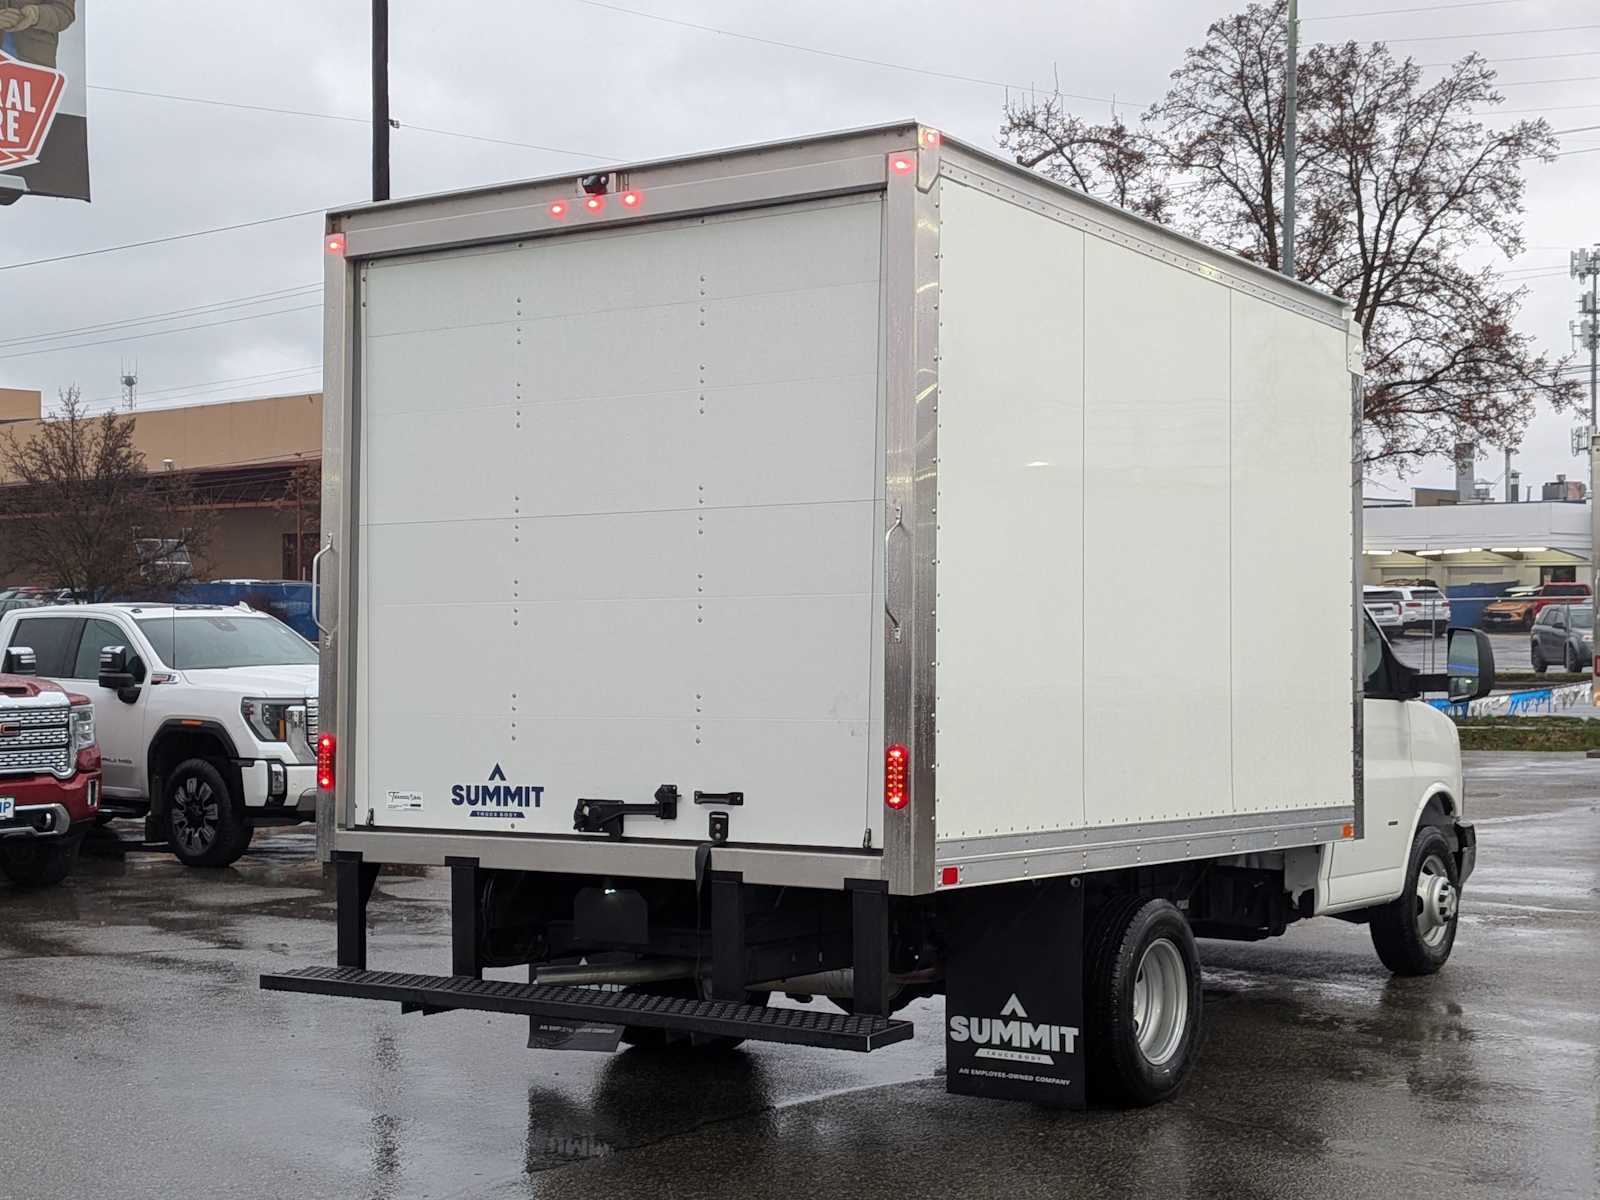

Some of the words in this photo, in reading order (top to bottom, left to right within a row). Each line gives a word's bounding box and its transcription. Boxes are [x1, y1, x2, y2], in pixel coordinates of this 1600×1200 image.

[0, 78, 36, 113] AL
[0, 109, 20, 143] E
[451, 784, 545, 808] SUMMIT
[949, 1015, 1079, 1053] SUMMIT
[958, 1067, 970, 1075] AN
[1035, 1075, 1070, 1085] COMPANY
